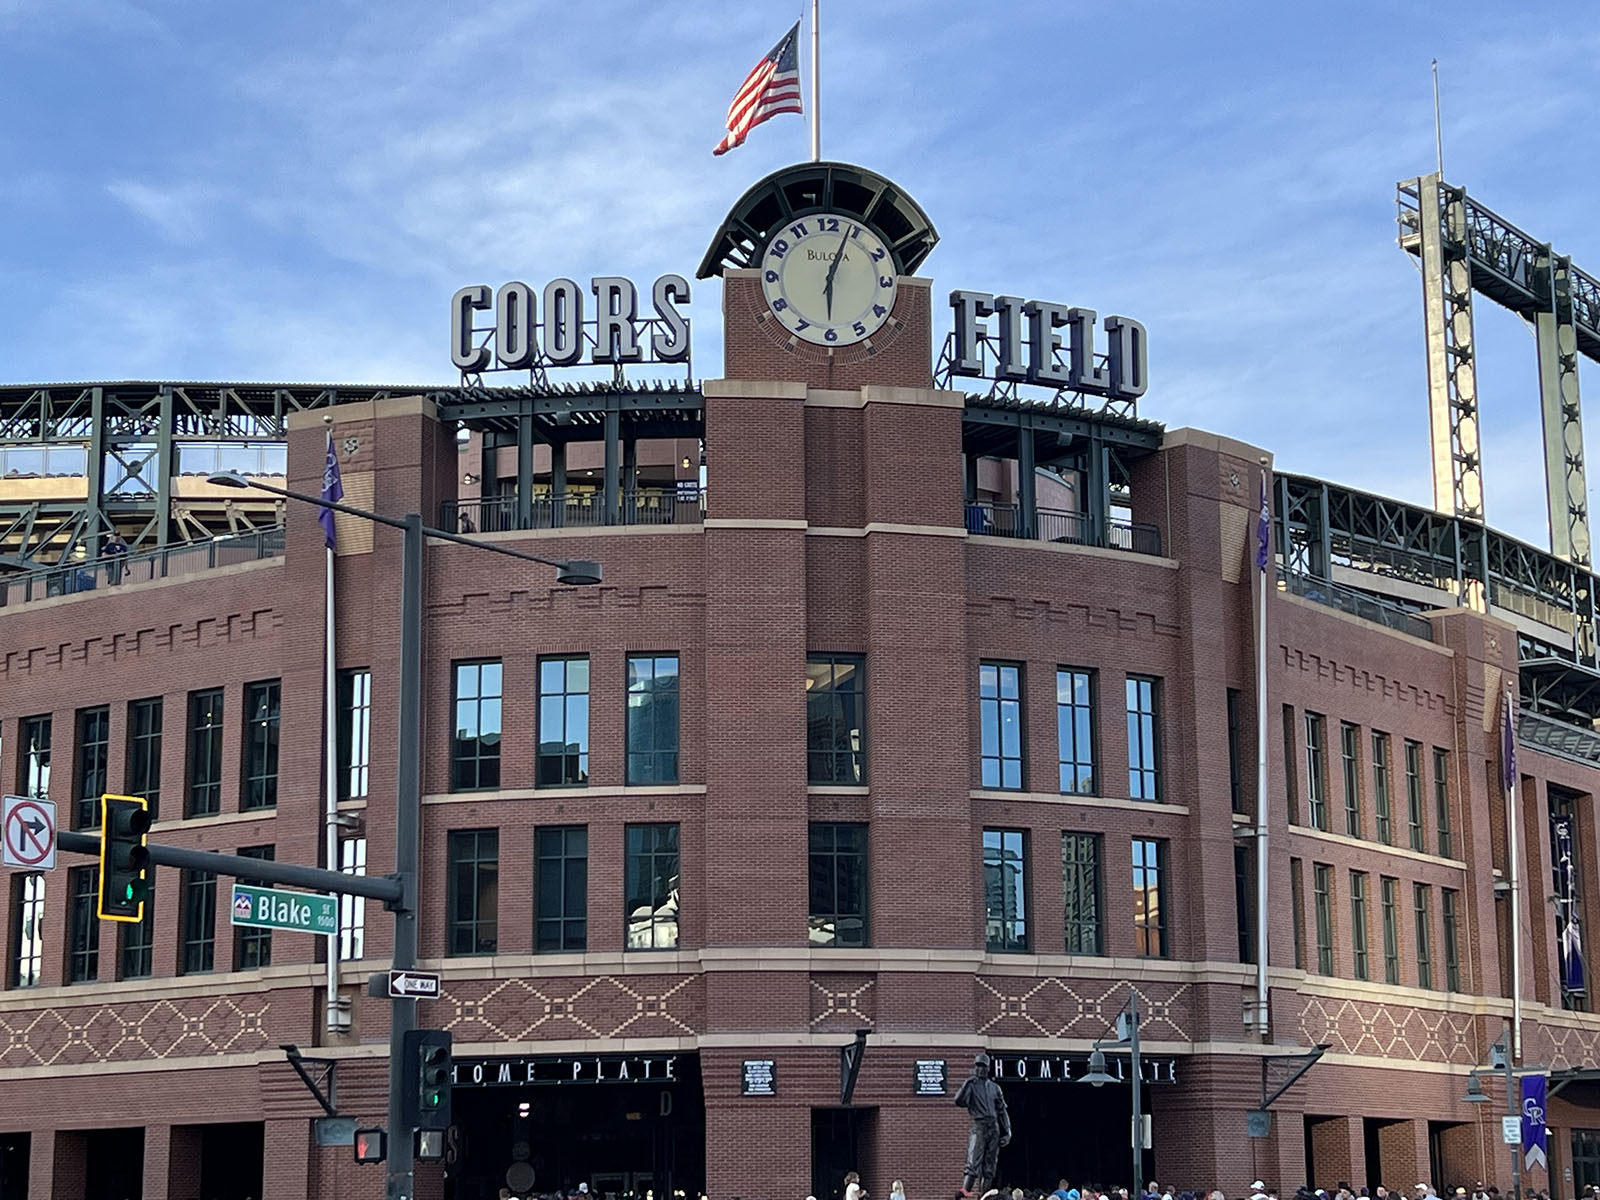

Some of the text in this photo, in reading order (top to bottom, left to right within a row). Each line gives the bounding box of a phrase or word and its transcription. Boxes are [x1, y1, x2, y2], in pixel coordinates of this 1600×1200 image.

[790, 223, 809, 239] 11
[817, 218, 840, 232] 12
[770, 239, 789, 259] 10
[807, 249, 850, 261] BULOA
[870, 247, 885, 262] 2
[765, 270, 780, 283] 9
[880, 276, 893, 288] 3
[772, 298, 788, 312] 8
[873, 304, 887, 318] 4
[451, 274, 691, 373] COORS
[794, 319, 810, 332] 7
[852, 321, 866, 336] 5
[824, 328, 838, 341] 6
[949, 289, 1148, 400] FIELD
[258, 896, 311, 925] Blake
[404, 979, 434, 990] ONE WAY
[573, 1059, 675, 1081] PLATE
[994, 1059, 1070, 1078] HOME
